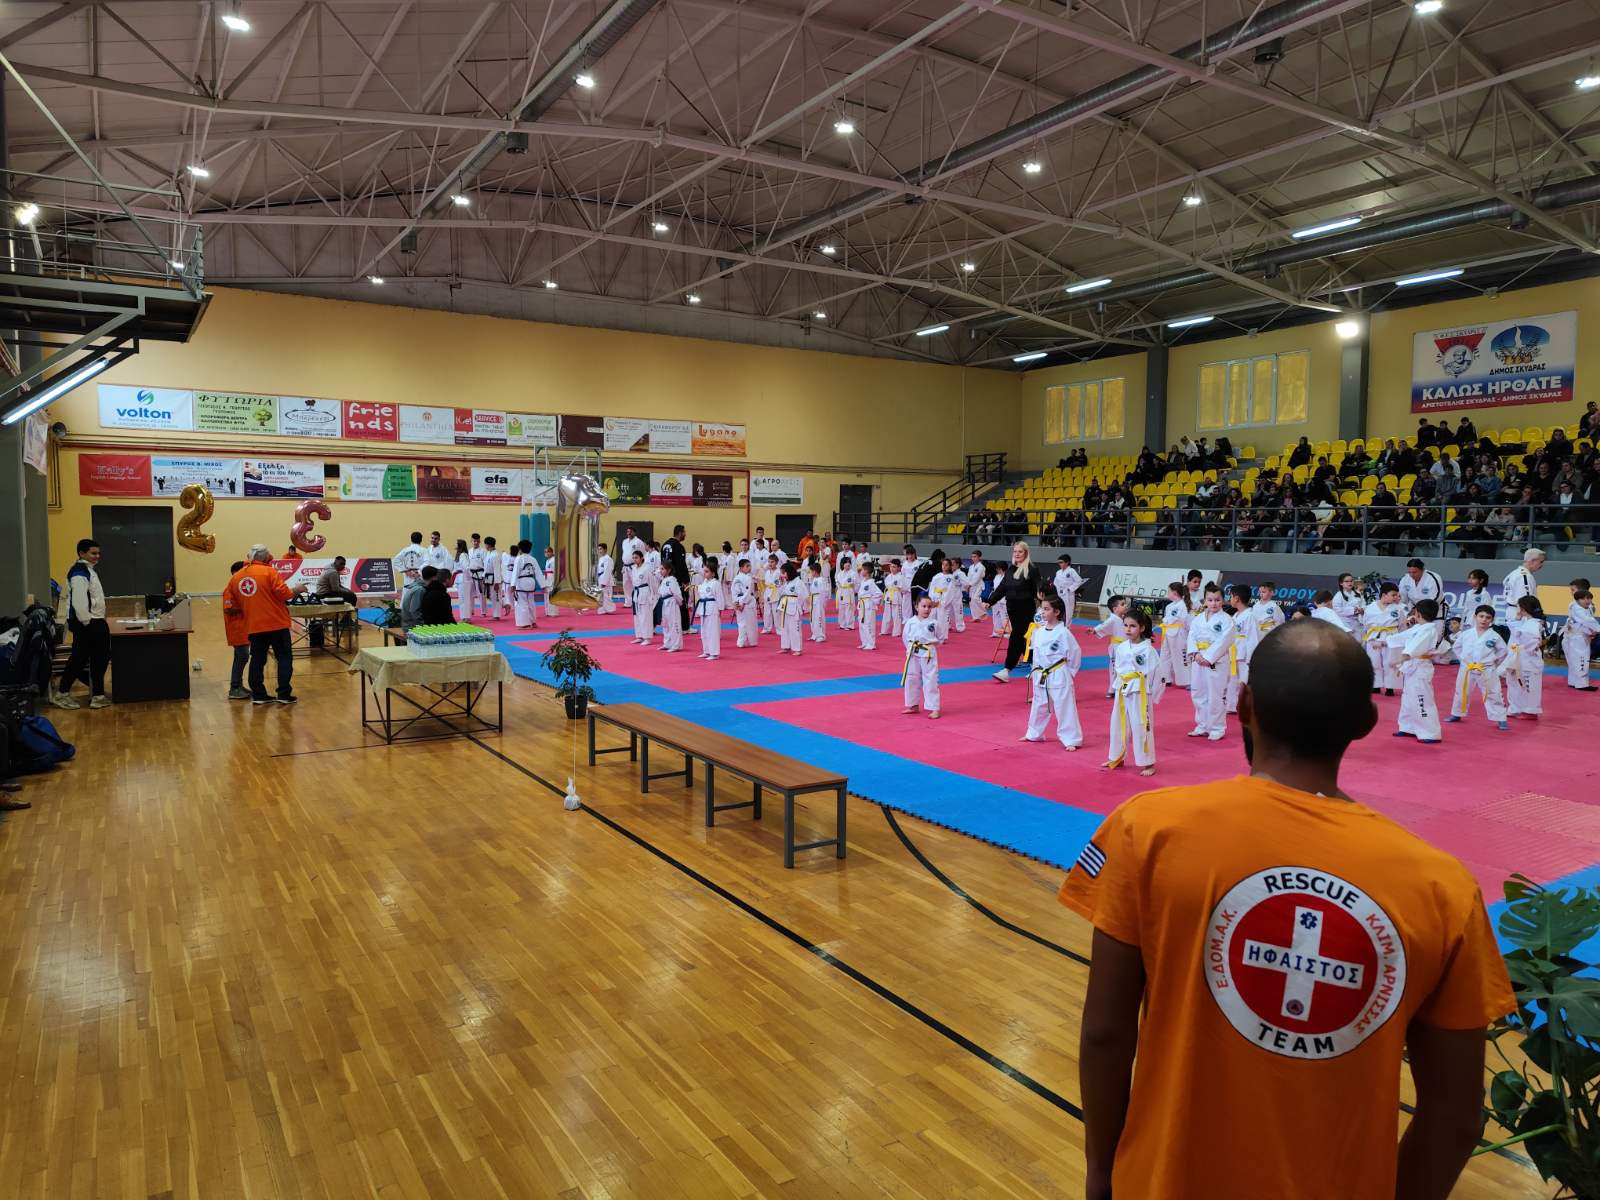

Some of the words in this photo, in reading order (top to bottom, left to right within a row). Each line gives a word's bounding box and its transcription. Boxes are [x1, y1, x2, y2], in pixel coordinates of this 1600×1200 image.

[1489, 367, 1515, 376] ΔΗΜΟΣ
[1515, 363, 1546, 374] ΣΚΥΔΡΑΣ
[1422, 383, 1483, 400] ΚΑΛΩΣ
[1487, 376, 1562, 395] ΗΡΘΑΤΕ
[116, 407, 171, 419] volton
[484, 475, 509, 484] efa
[1263, 872, 1360, 910] RESCUE
[1365, 913, 1396, 960] ΚΛΙΜ.
[1249, 945, 1360, 984] ΗΦΑΙΣΤΟΣ
[1353, 964, 1397, 1034] ΑΡΝΙΣΣΑΣ
[1258, 1023, 1335, 1054] TEAM
